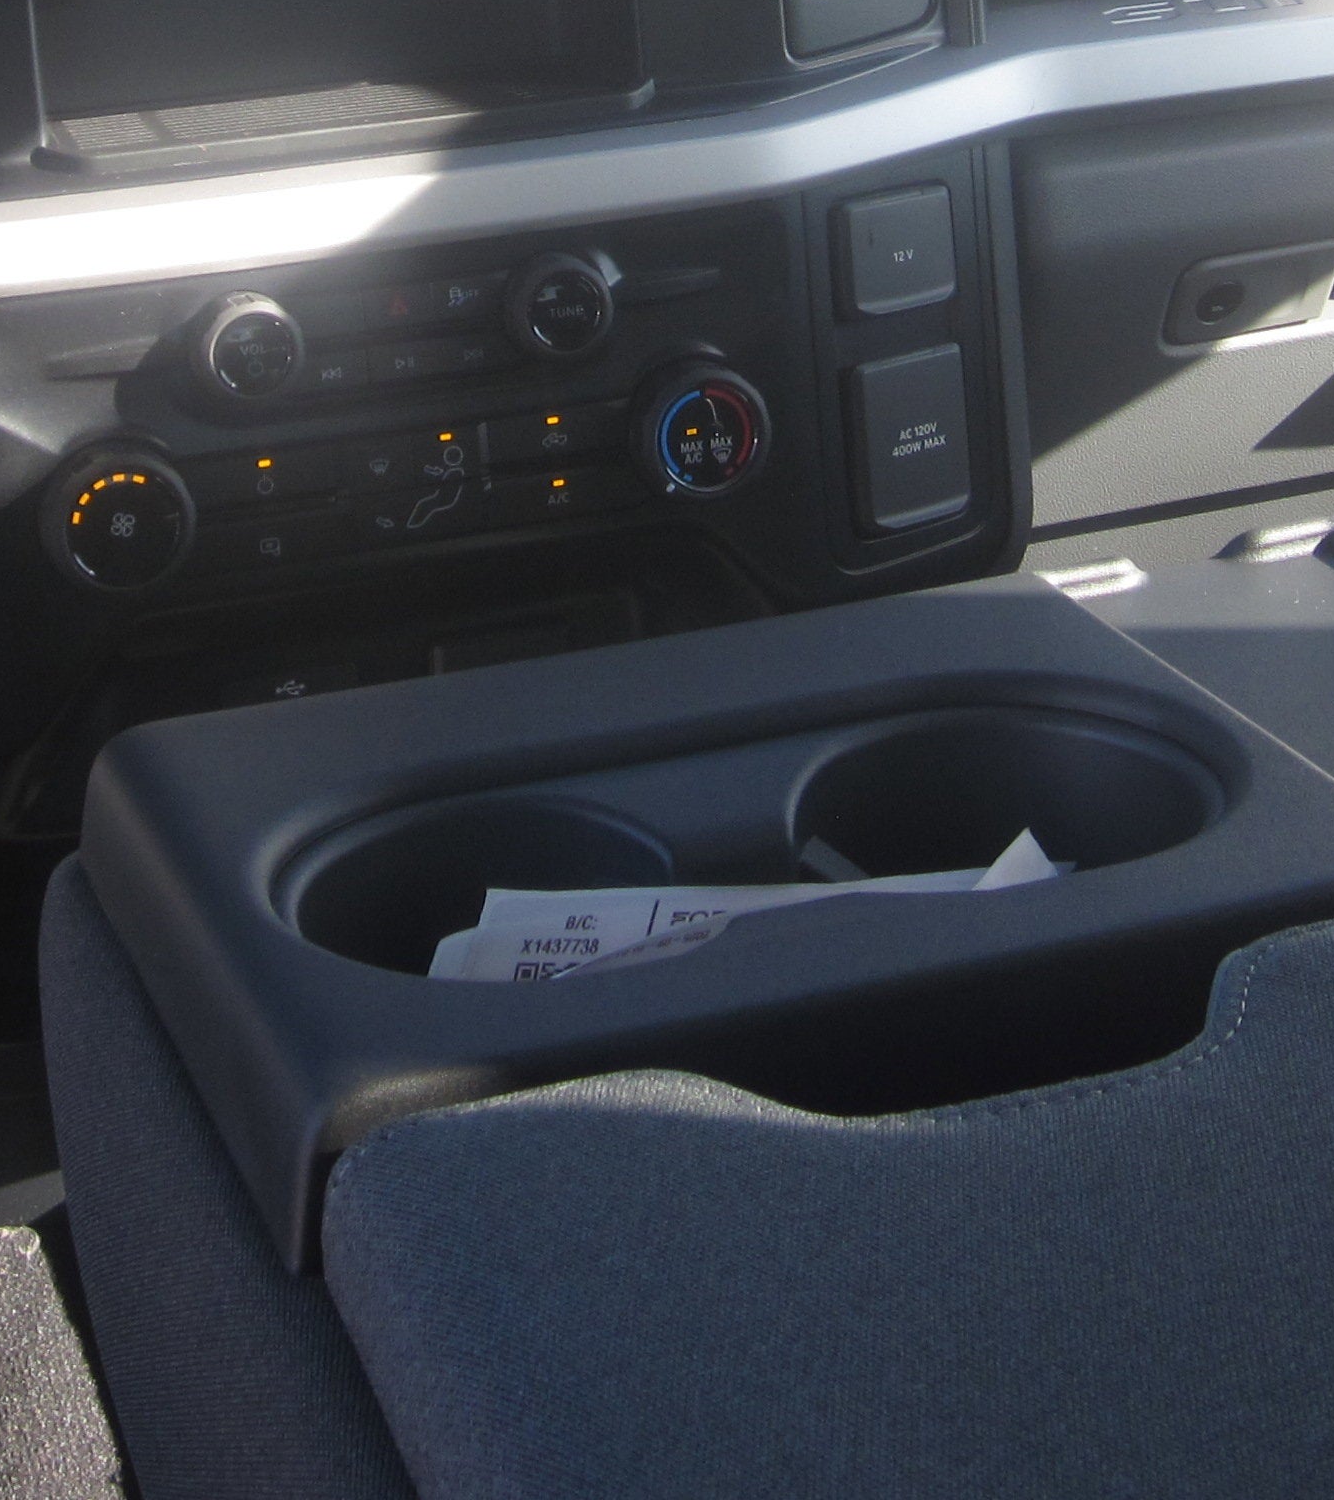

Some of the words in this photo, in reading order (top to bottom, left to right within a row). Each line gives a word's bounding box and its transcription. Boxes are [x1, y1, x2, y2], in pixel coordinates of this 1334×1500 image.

[549, 306, 585, 319] TUNE
[239, 343, 267, 356] VOL
[899, 428, 913, 441] AC
[914, 422, 938, 437] 120V
[680, 440, 705, 454] MAX
[710, 436, 733, 449] MAX
[892, 442, 923, 458] 400W
[924, 434, 947, 450] MAX
[684, 452, 704, 465] A/C
[565, 915, 598, 930] B/C:
[520, 938, 600, 955] X1437738
